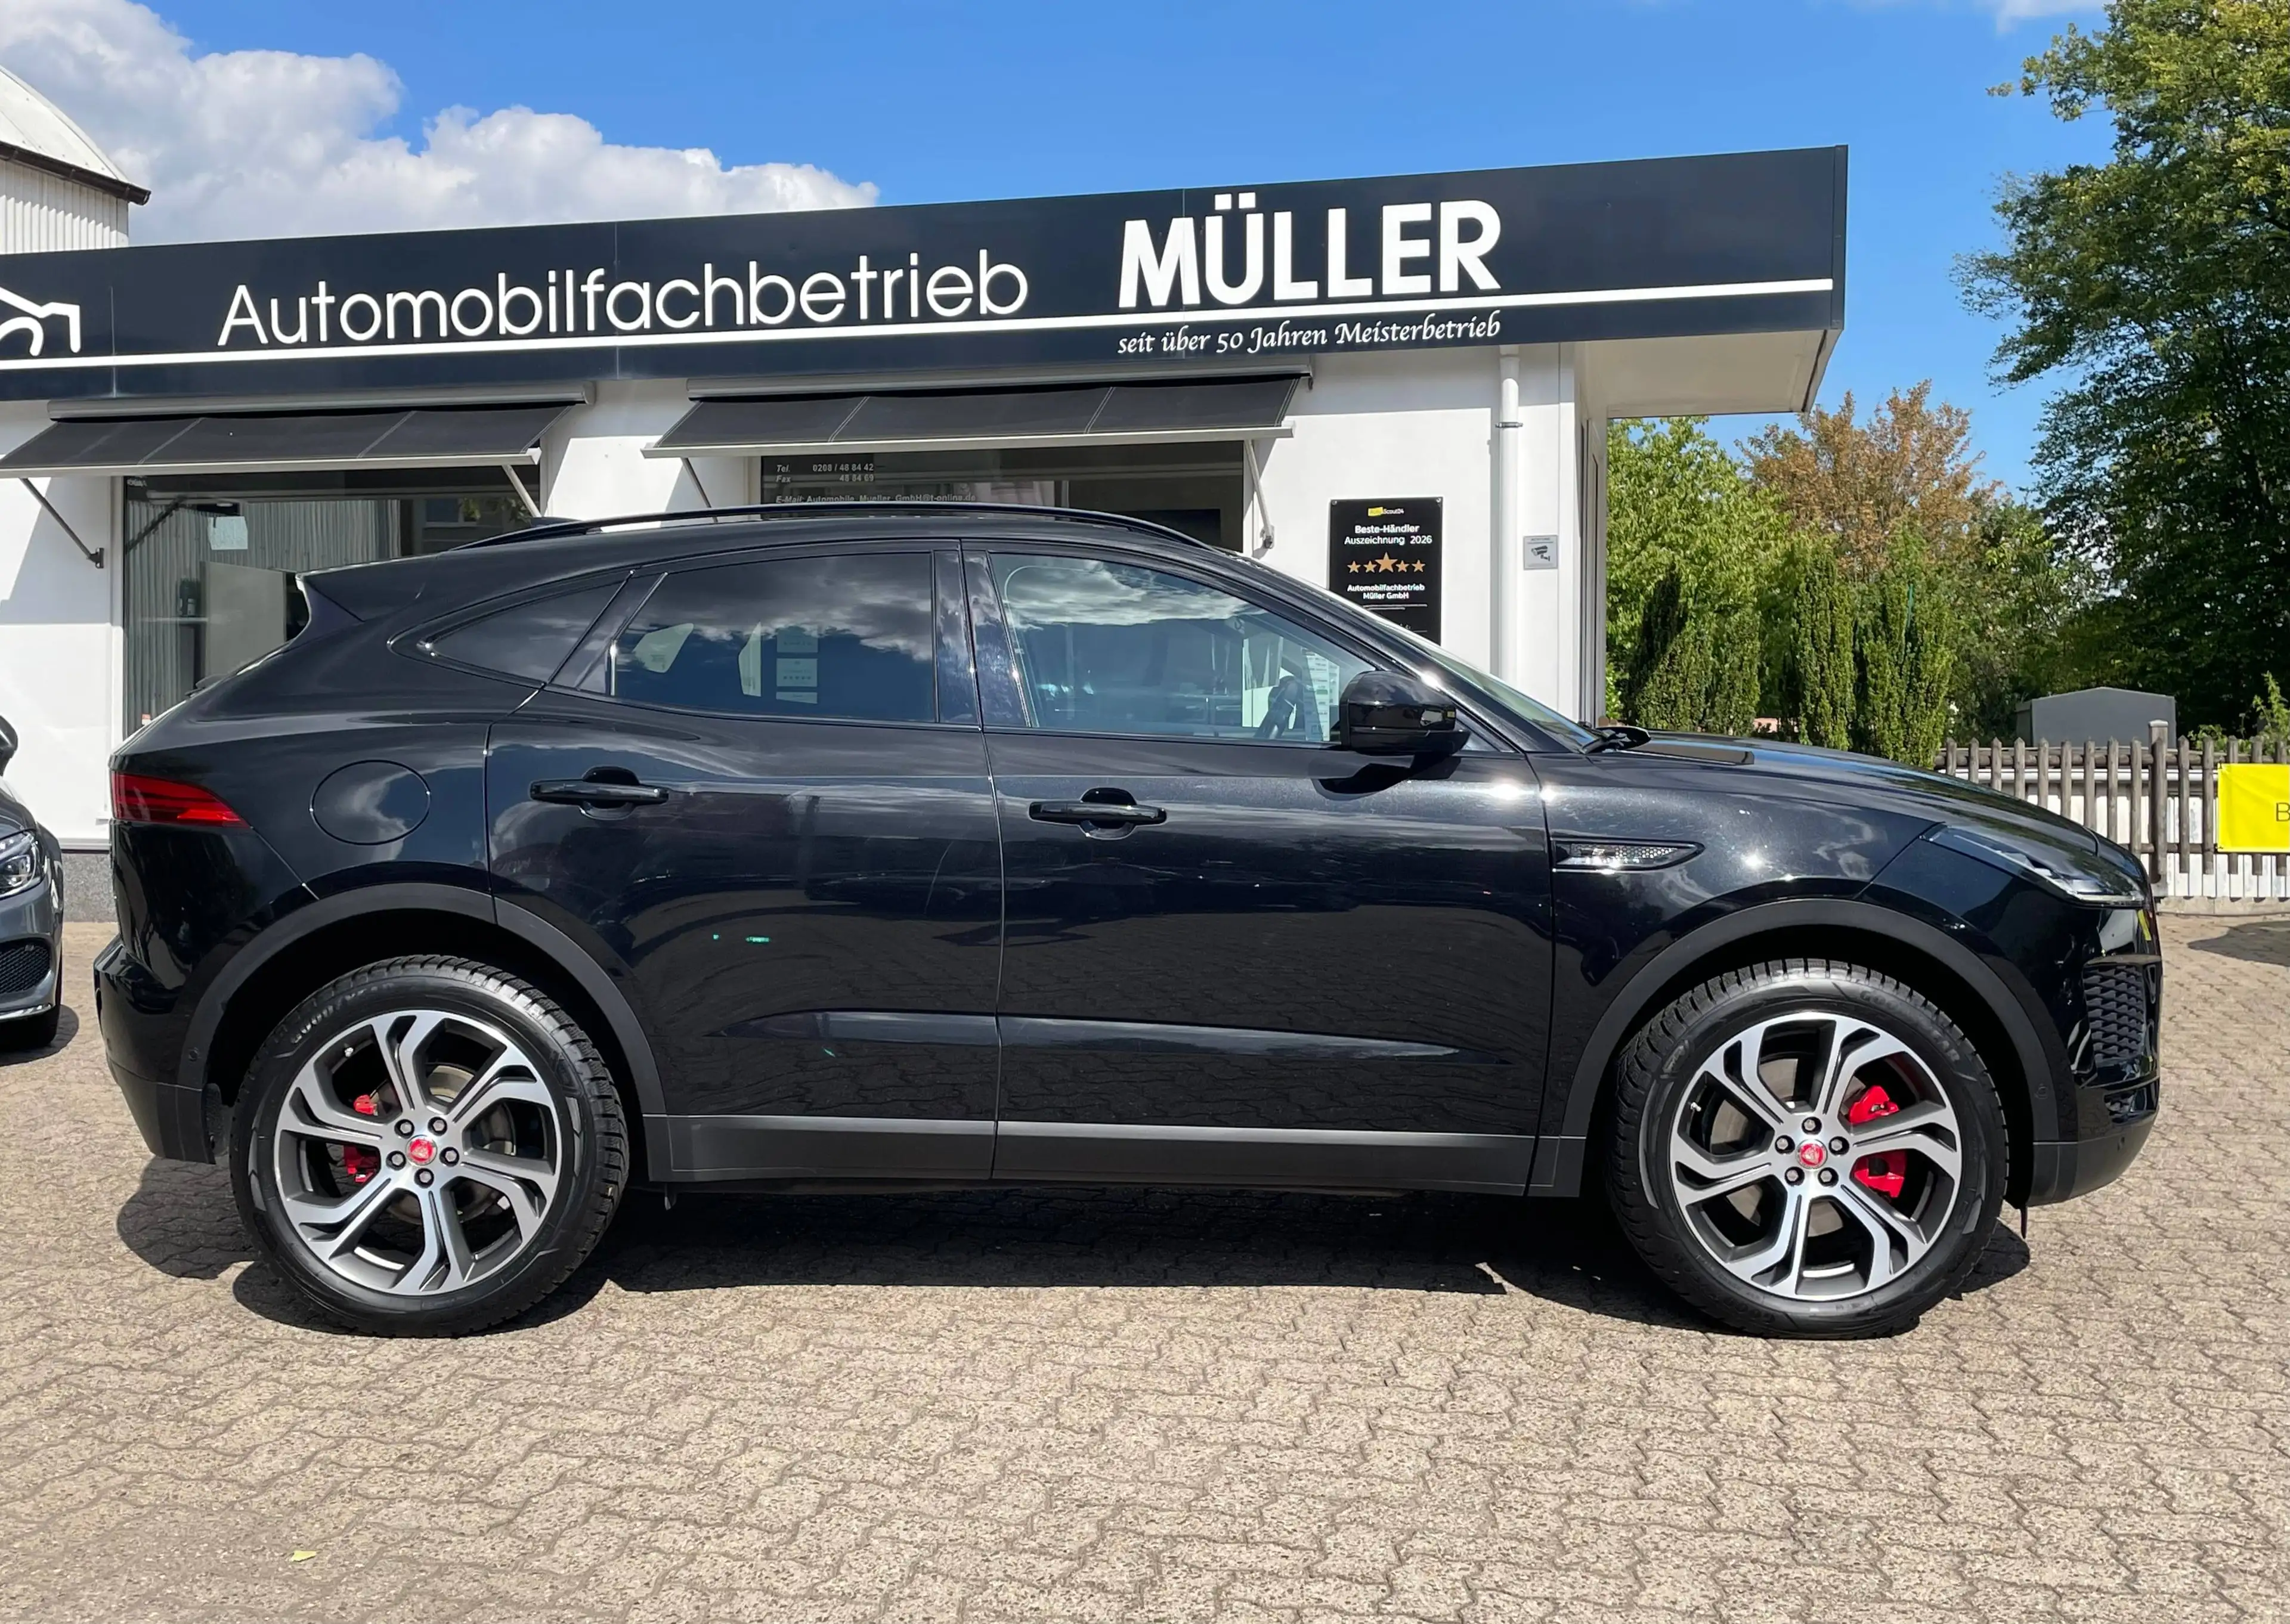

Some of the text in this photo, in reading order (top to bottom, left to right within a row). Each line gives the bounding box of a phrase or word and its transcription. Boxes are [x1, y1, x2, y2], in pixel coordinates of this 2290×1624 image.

[217, 192, 1502, 346] Automobilfachbetrieb MÜLLER
[1118, 309, 1501, 354] seit über 50 Jahren Meisterbetrieb
[1354, 524, 1421, 534] Beste-Händler
[1344, 535, 1433, 546] Auszeichnung 2026
[1347, 583, 1425, 591] Automobilfachbetrieb
